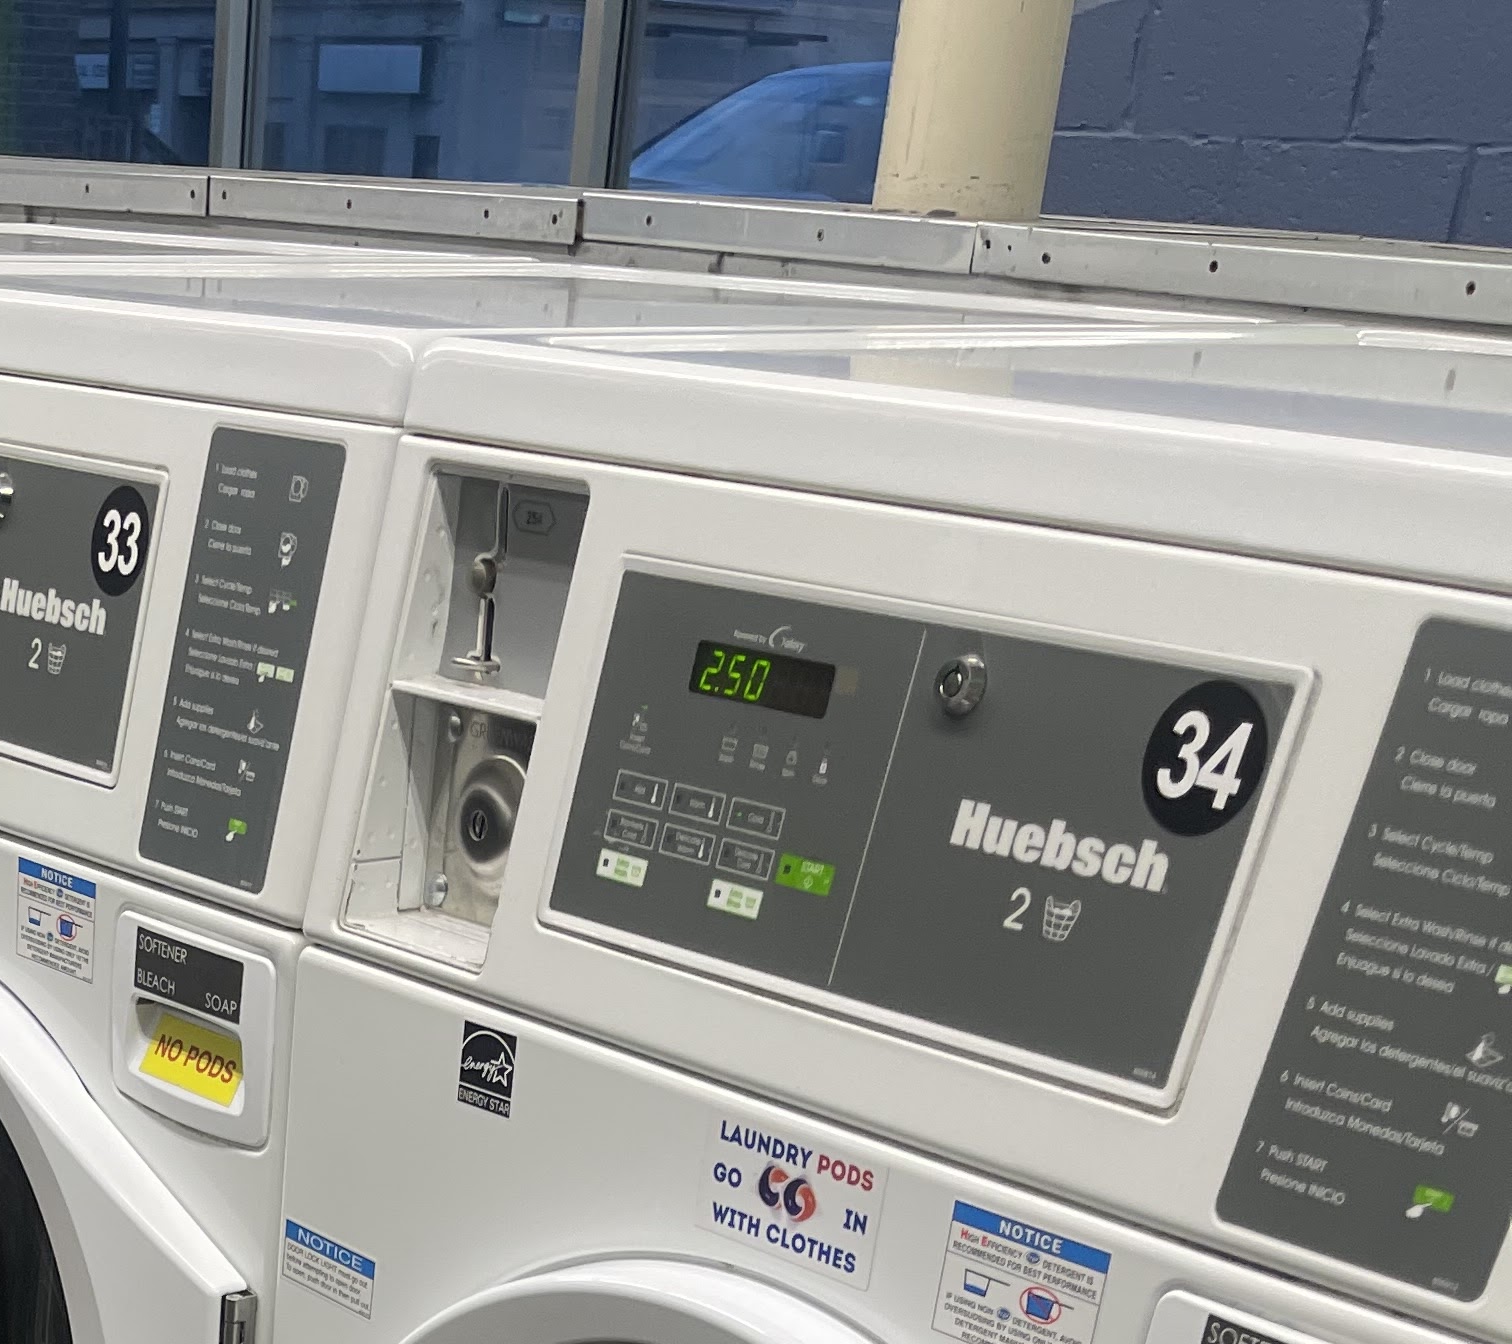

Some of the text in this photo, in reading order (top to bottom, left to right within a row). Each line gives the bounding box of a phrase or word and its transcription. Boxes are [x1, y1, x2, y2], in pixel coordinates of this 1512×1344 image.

[97, 508, 142, 576] 33
[0, 577, 107, 635] Huebsch
[27, 637, 42, 669] 2
[699, 650, 771, 701] 2.50
[1157, 709, 1254, 811] 34
[949, 798, 1170, 894] Huebsch
[40, 867, 73, 889] NOTICE
[1002, 886, 1032, 931] 2
[138, 933, 188, 966] SOFTENER
[136, 967, 176, 996] BLEACH
[204, 992, 238, 1016] SOAP
[1320, 1000, 1346, 1019] Add
[1345, 1008, 1395, 1032] supplies
[1310, 1025, 1360, 1049] Agregar
[154, 1033, 238, 1084] NO PODS
[1280, 1069, 1290, 1083] 6
[1292, 1072, 1325, 1093] Insert
[458, 1087, 510, 1117] ENERGY STAR
[1284, 1097, 1346, 1127] Introduzca
[719, 1119, 875, 1192] LAUNDRY PODS
[1255, 1140, 1329, 1174] 7 Push START
[712, 1162, 869, 1236] GO IN
[1259, 1167, 1347, 1206] Presione INICIO
[297, 1227, 364, 1273] NOTICE
[712, 1201, 857, 1274] WITH CLOTHES
[998, 1219, 1065, 1255] NOTICE
[952, 1239, 1098, 1301] RECOMMENDED FOR BEST PERFORMANCE
[960, 1227, 980, 1246] HIGH
[1042, 1259, 1087, 1286] DETERGENT
[1086, 1275, 1095, 1287] IS
[954, 1317, 999, 1341] DETERGENT
